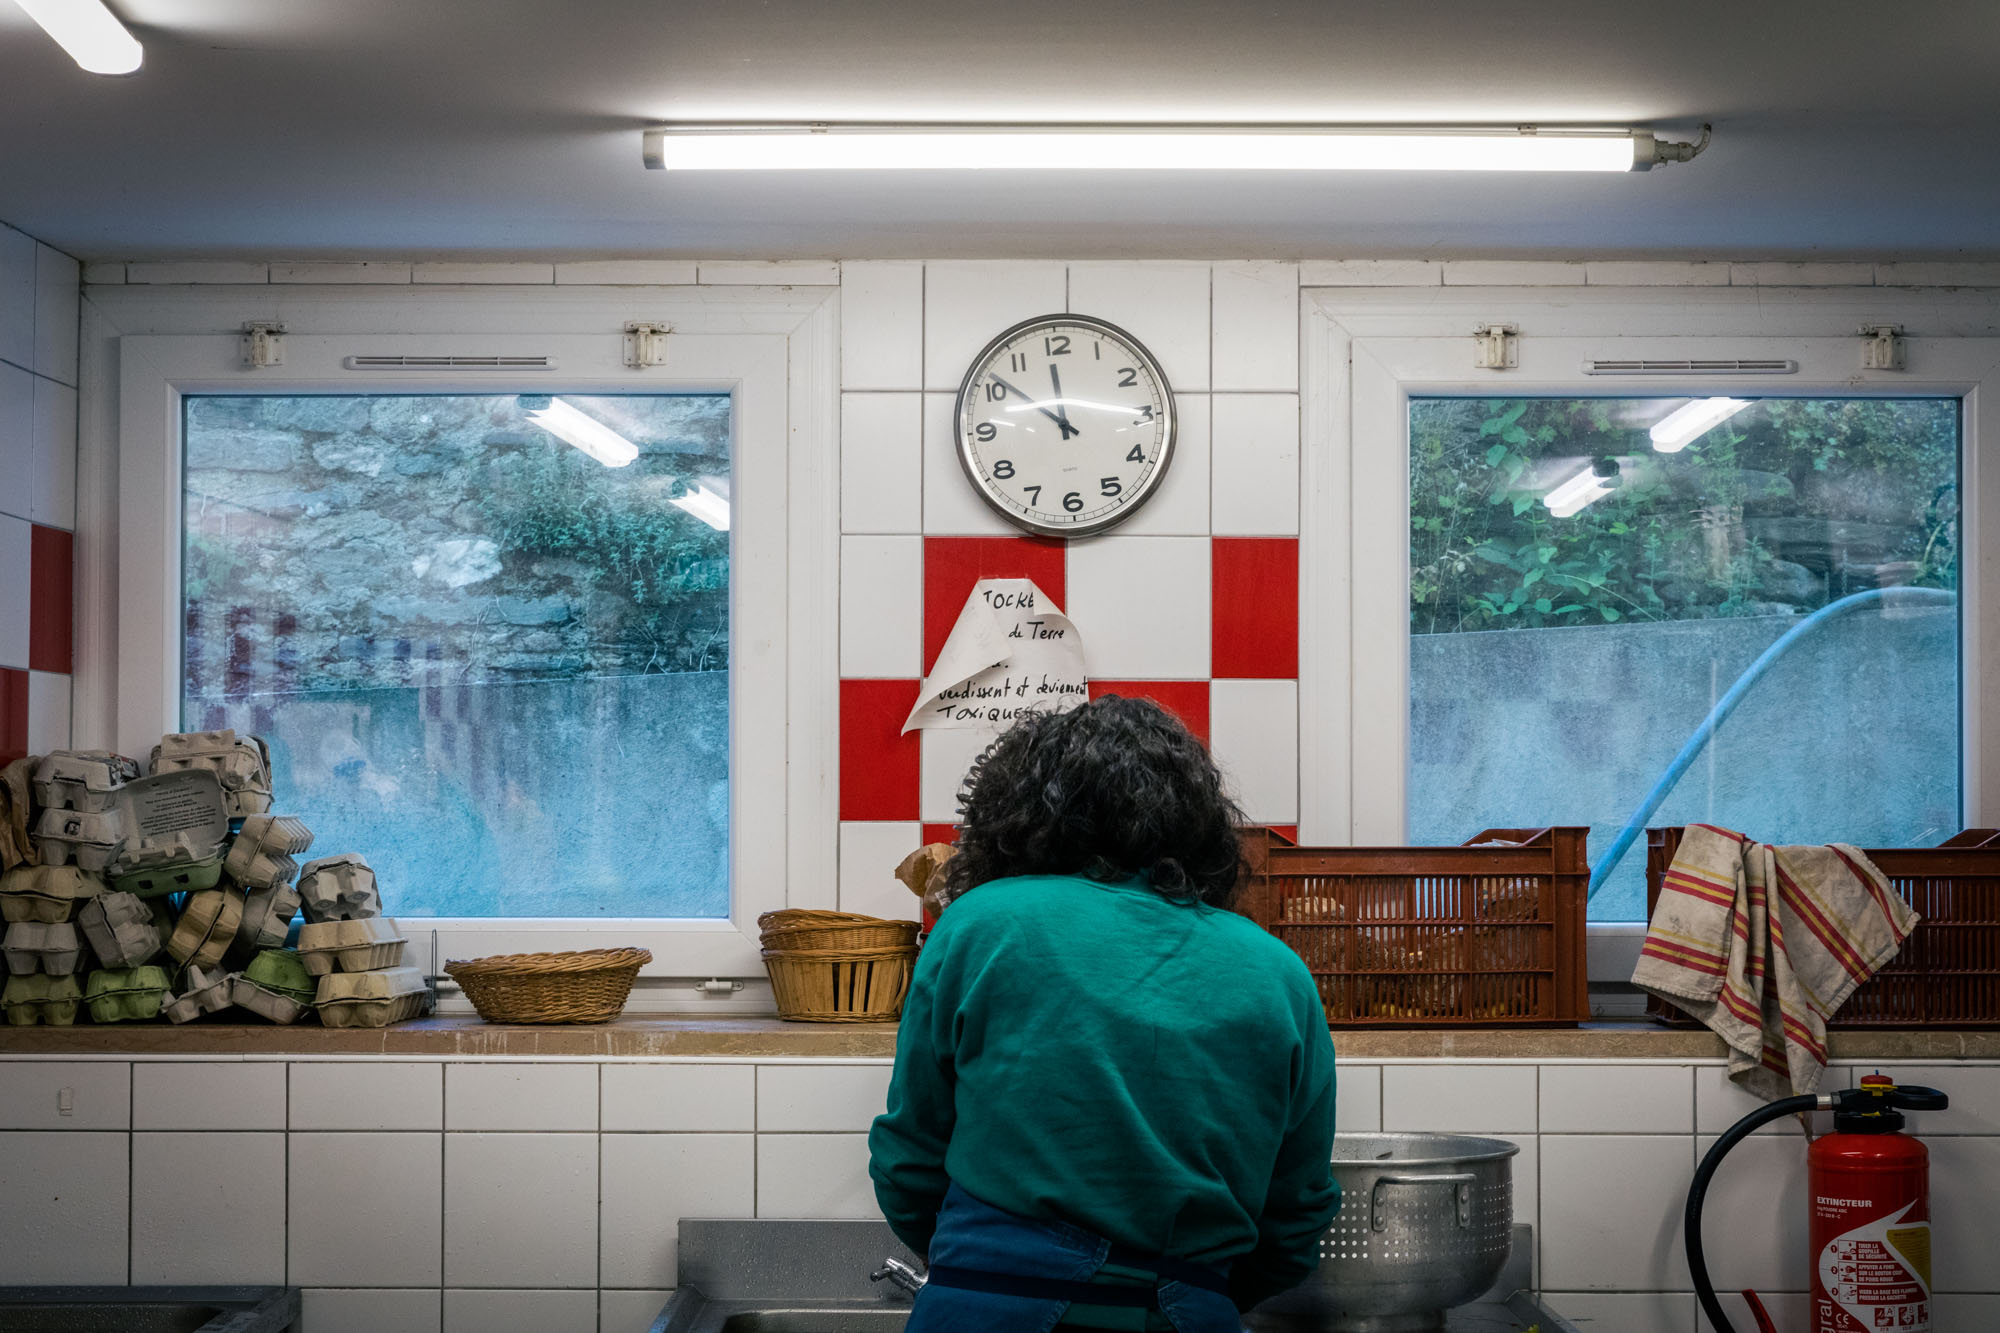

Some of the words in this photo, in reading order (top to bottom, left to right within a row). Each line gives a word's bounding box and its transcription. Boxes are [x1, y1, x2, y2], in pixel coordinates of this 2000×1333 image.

[1045, 336, 1071, 356] 12
[1094, 341, 1100, 360] 1
[1011, 353, 1026, 372] 11
[1118, 367, 1137, 388] 2
[985, 381, 1006, 402] 10
[1133, 405, 1154, 426] 3
[976, 422, 997, 442] 9
[1126, 444, 1146, 464] 4
[993, 460, 1015, 479] 8
[1023, 485, 1042, 506] 7
[1100, 476, 1122, 497] 5
[1062, 491, 1084, 512] 6
[1008, 623, 1024, 638] de
[1026, 621, 1065, 640] Terre
[1016, 676, 1030, 697] et
[1816, 1196, 1873, 1208] EXTINCTEUR
[1835, 1312, 1850, 1325] CE
